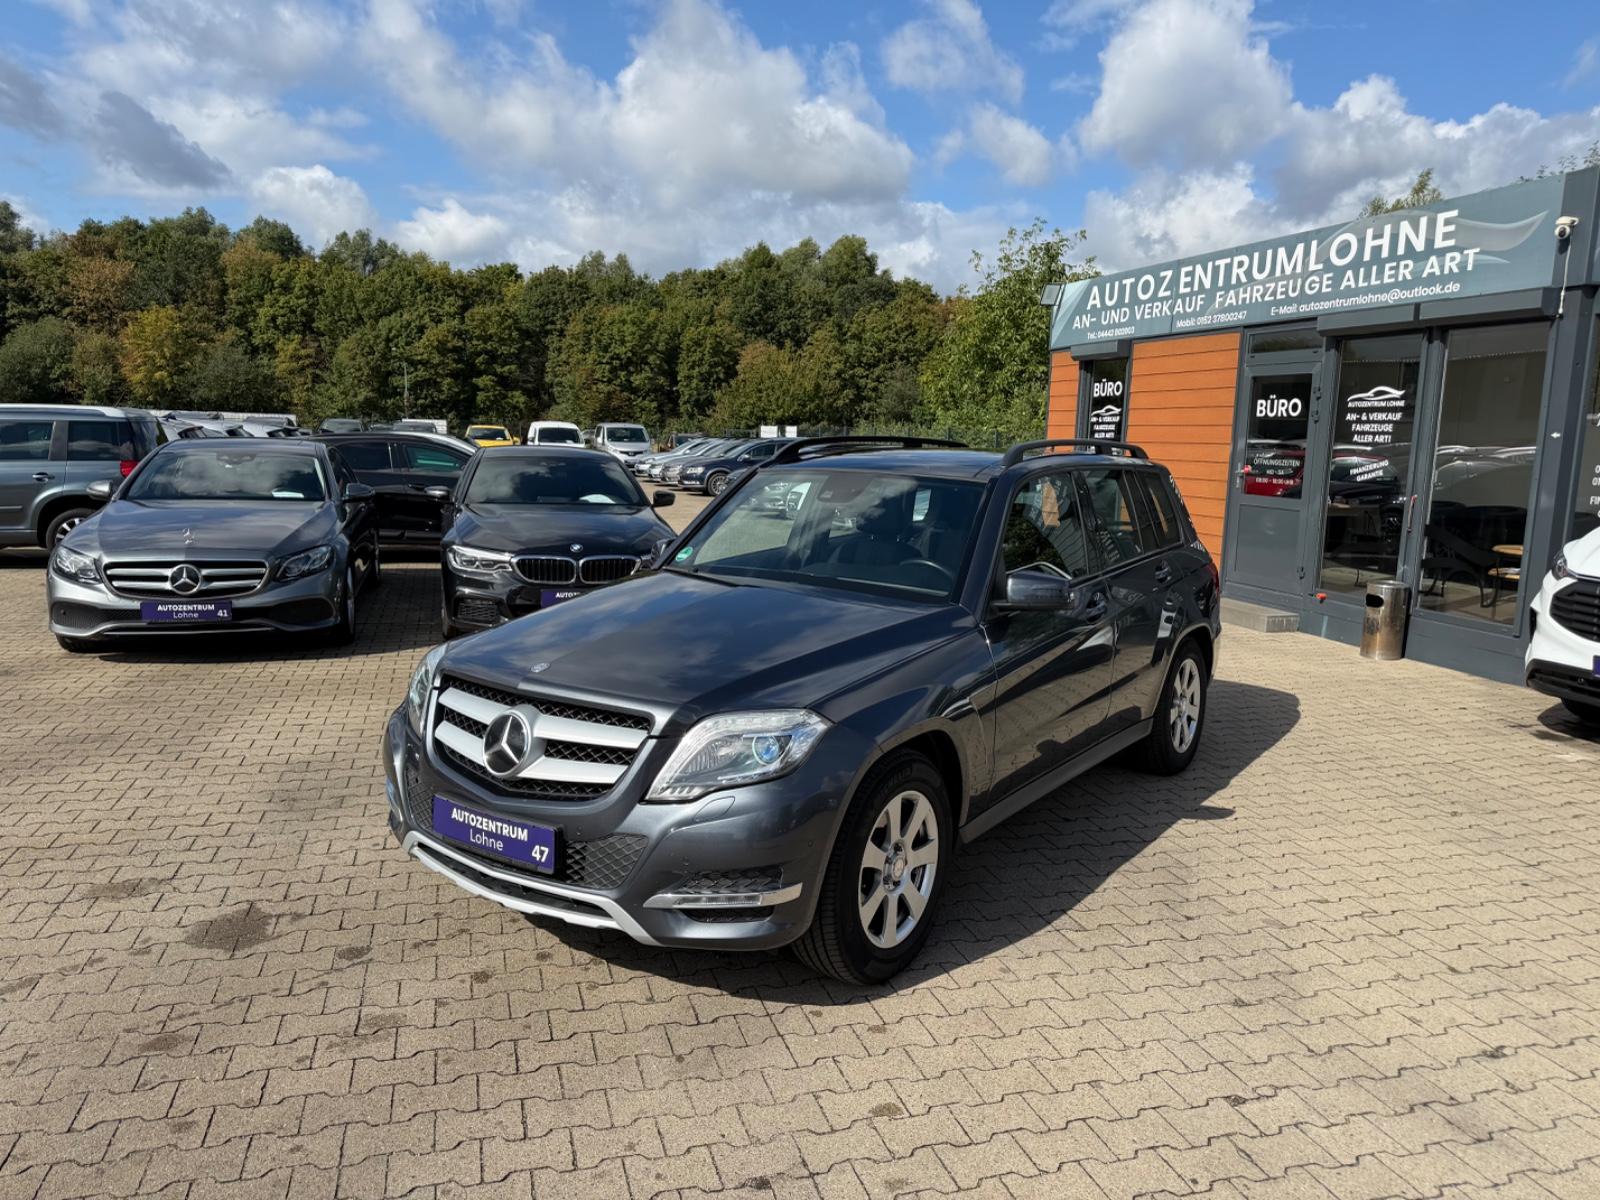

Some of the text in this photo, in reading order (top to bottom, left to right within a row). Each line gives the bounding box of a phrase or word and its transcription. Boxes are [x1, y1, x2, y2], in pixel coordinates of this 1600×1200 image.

[1072, 248, 1481, 330] AN- UND VERKAUF FAHRZEUGE ALLER ART
[1299, 281, 1461, 313] autozentrumlohne@outlook.de
[1093, 378, 1123, 398] BÜRO
[1256, 394, 1302, 417] BÜRO
[1345, 412, 1402, 421] AN- & VERKAUF
[1351, 423, 1394, 432] FAHRZEUGE
[1352, 434, 1373, 443] ALLER
[157, 604, 215, 612] AUTOZENTRUM
[173, 609, 228, 619] Lohne 41
[451, 807, 529, 842] AUTOZENTRUM
[469, 828, 504, 852] Lohne
[531, 844, 549, 863] 47
